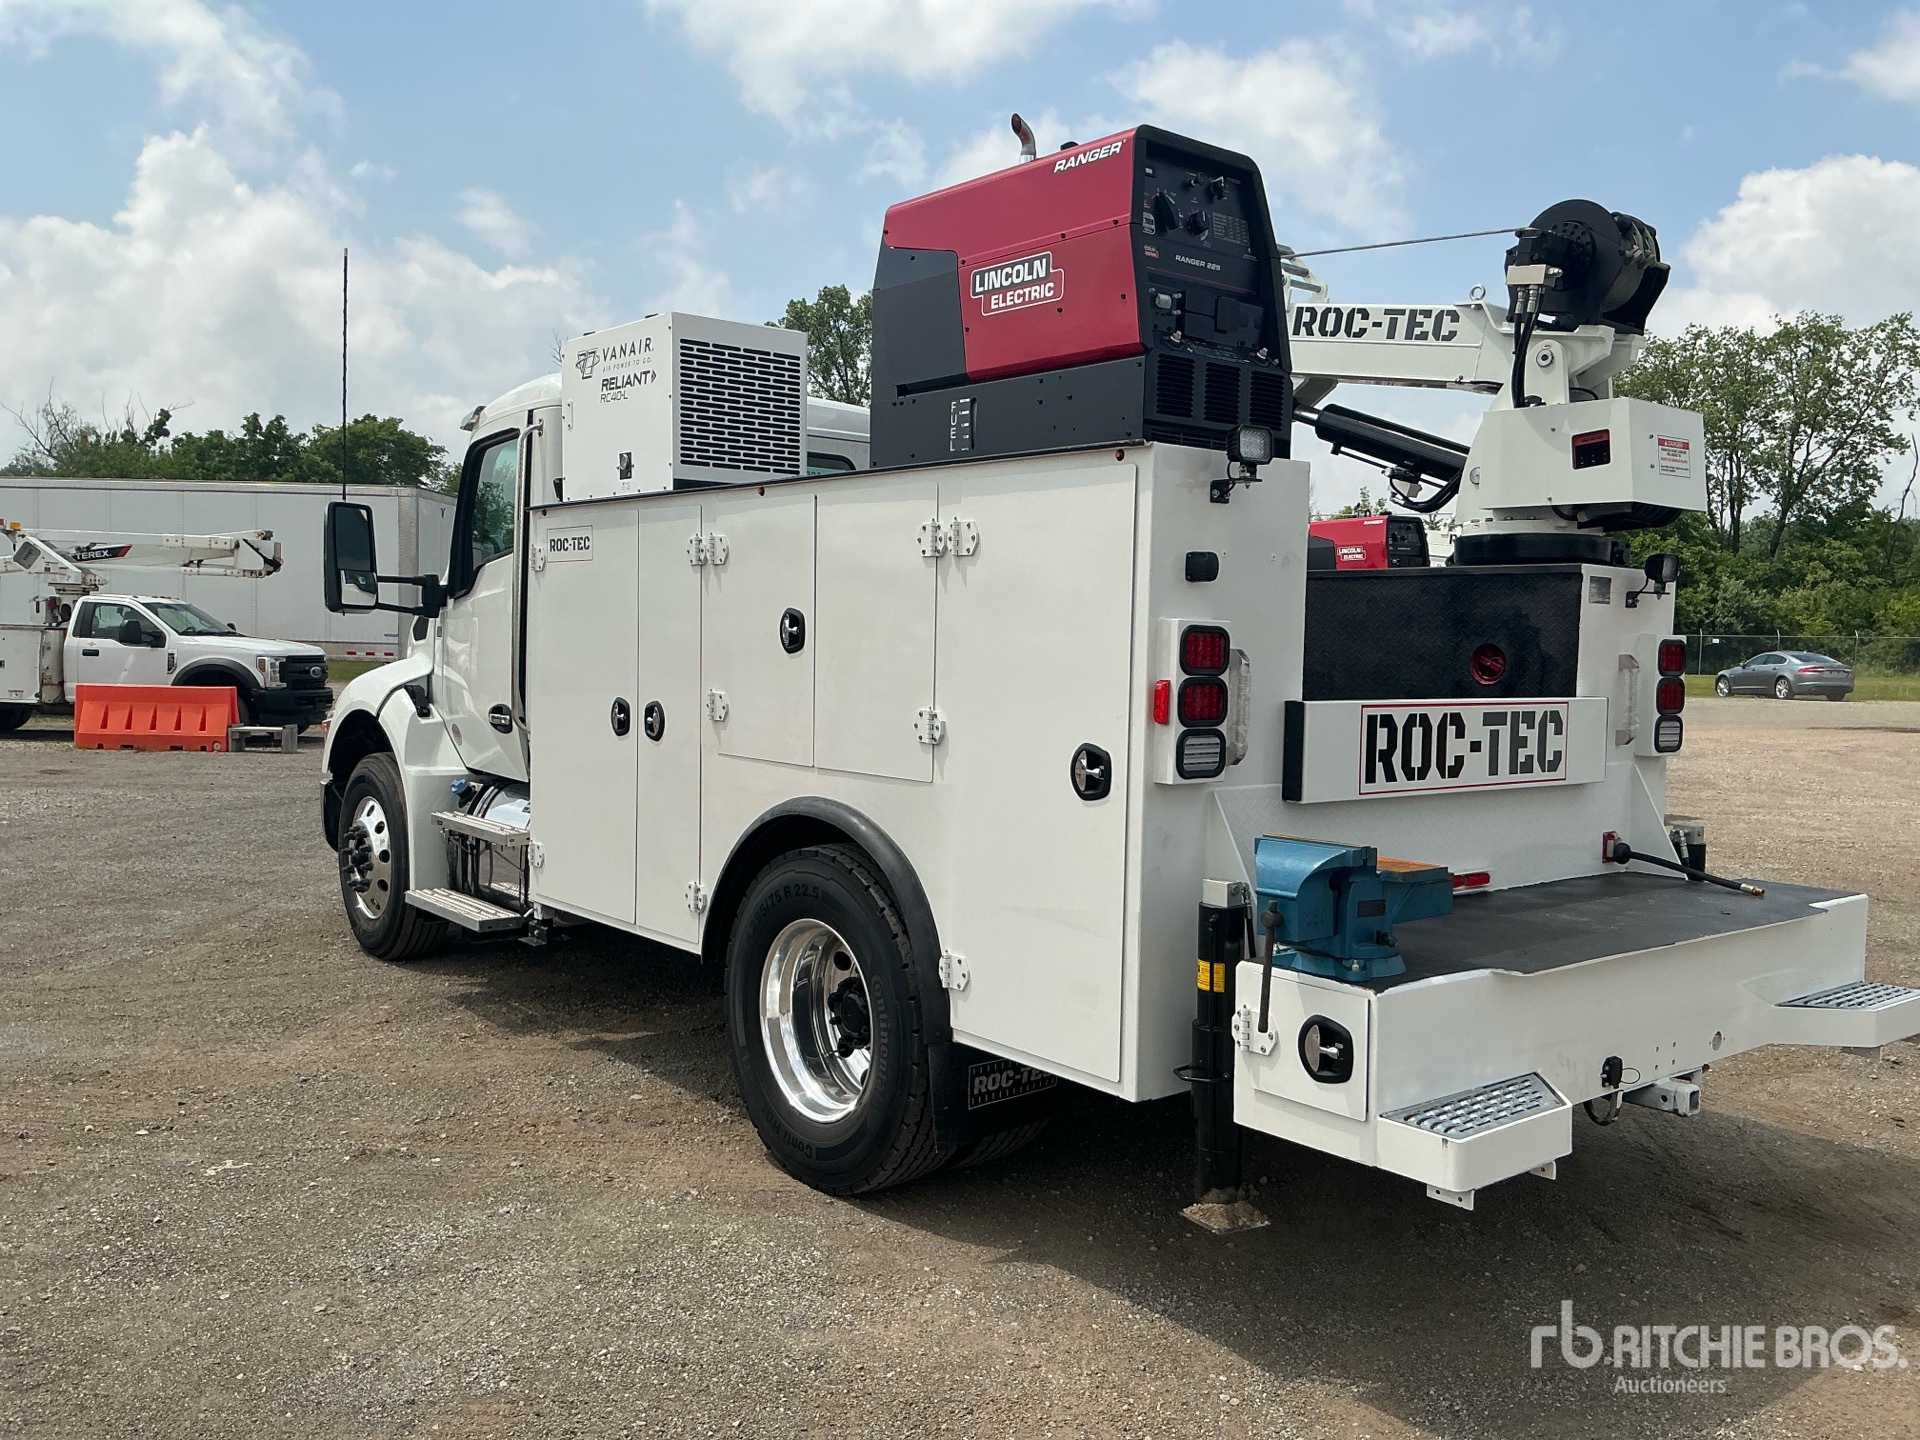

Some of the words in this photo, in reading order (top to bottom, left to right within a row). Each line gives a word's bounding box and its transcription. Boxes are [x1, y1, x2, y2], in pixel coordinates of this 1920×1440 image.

[1053, 141, 1123, 174] RANGER
[1175, 254, 1206, 268] RANGER
[975, 257, 1047, 293] LINCOLN
[990, 282, 1055, 310] ELECTRIC
[1291, 306, 1461, 342] ROC-TEC
[602, 337, 652, 362] VANAIR
[601, 370, 650, 392] RELIANT
[949, 401, 958, 452] FUEL
[76, 549, 110, 560] TEREX
[549, 536, 590, 552] ROC-TEC
[1364, 710, 1564, 785] ROC-TEC
[794, 883, 820, 900] 22.5
